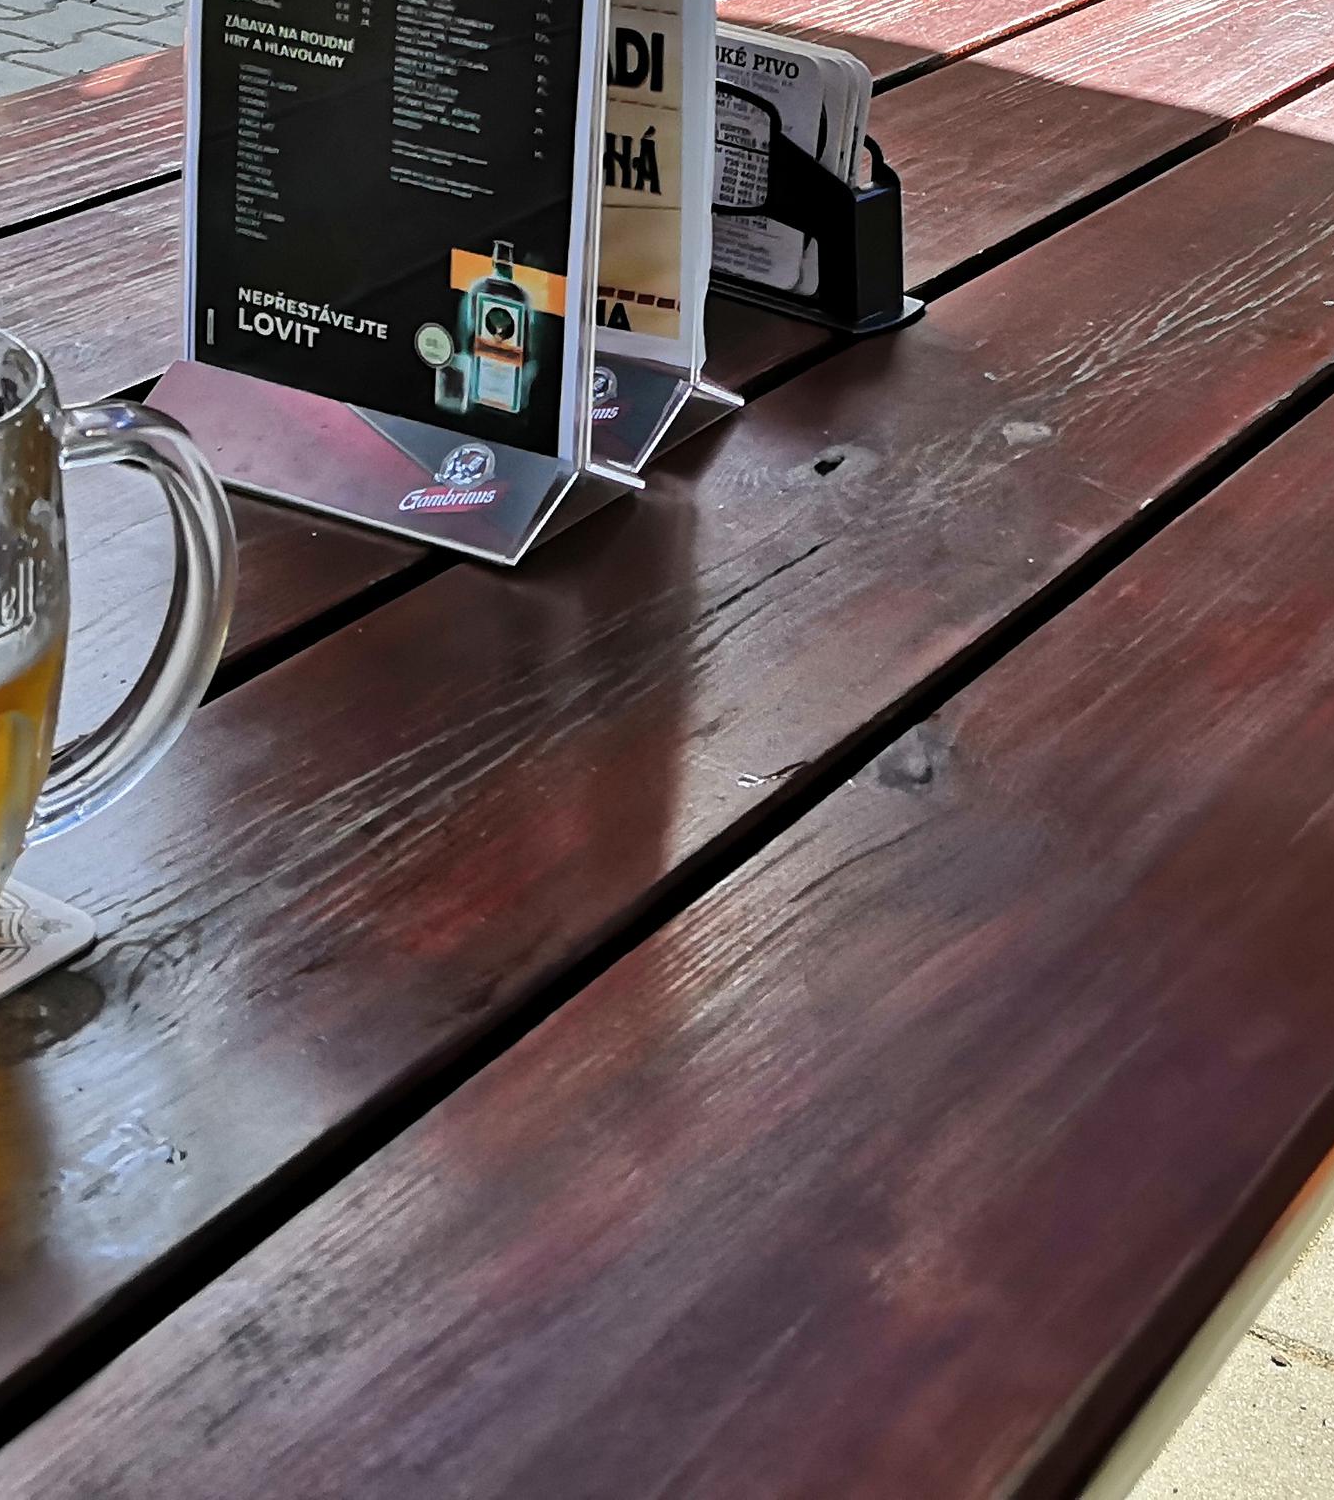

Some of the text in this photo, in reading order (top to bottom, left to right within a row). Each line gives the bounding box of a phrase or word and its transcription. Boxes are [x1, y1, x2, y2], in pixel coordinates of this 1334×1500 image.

[224, 32, 345, 68] HRY A HLAVOLAMY
[225, 14, 355, 53] ZÁBAVA NA ROUDNÉ
[607, 27, 664, 92] DI
[715, 44, 747, 68] KÉ
[752, 54, 799, 79] PIVO
[238, 286, 388, 340] NEPŘESTÁVEJTE
[238, 307, 321, 348] LOVIT
[398, 486, 498, 512] Gambrinus
